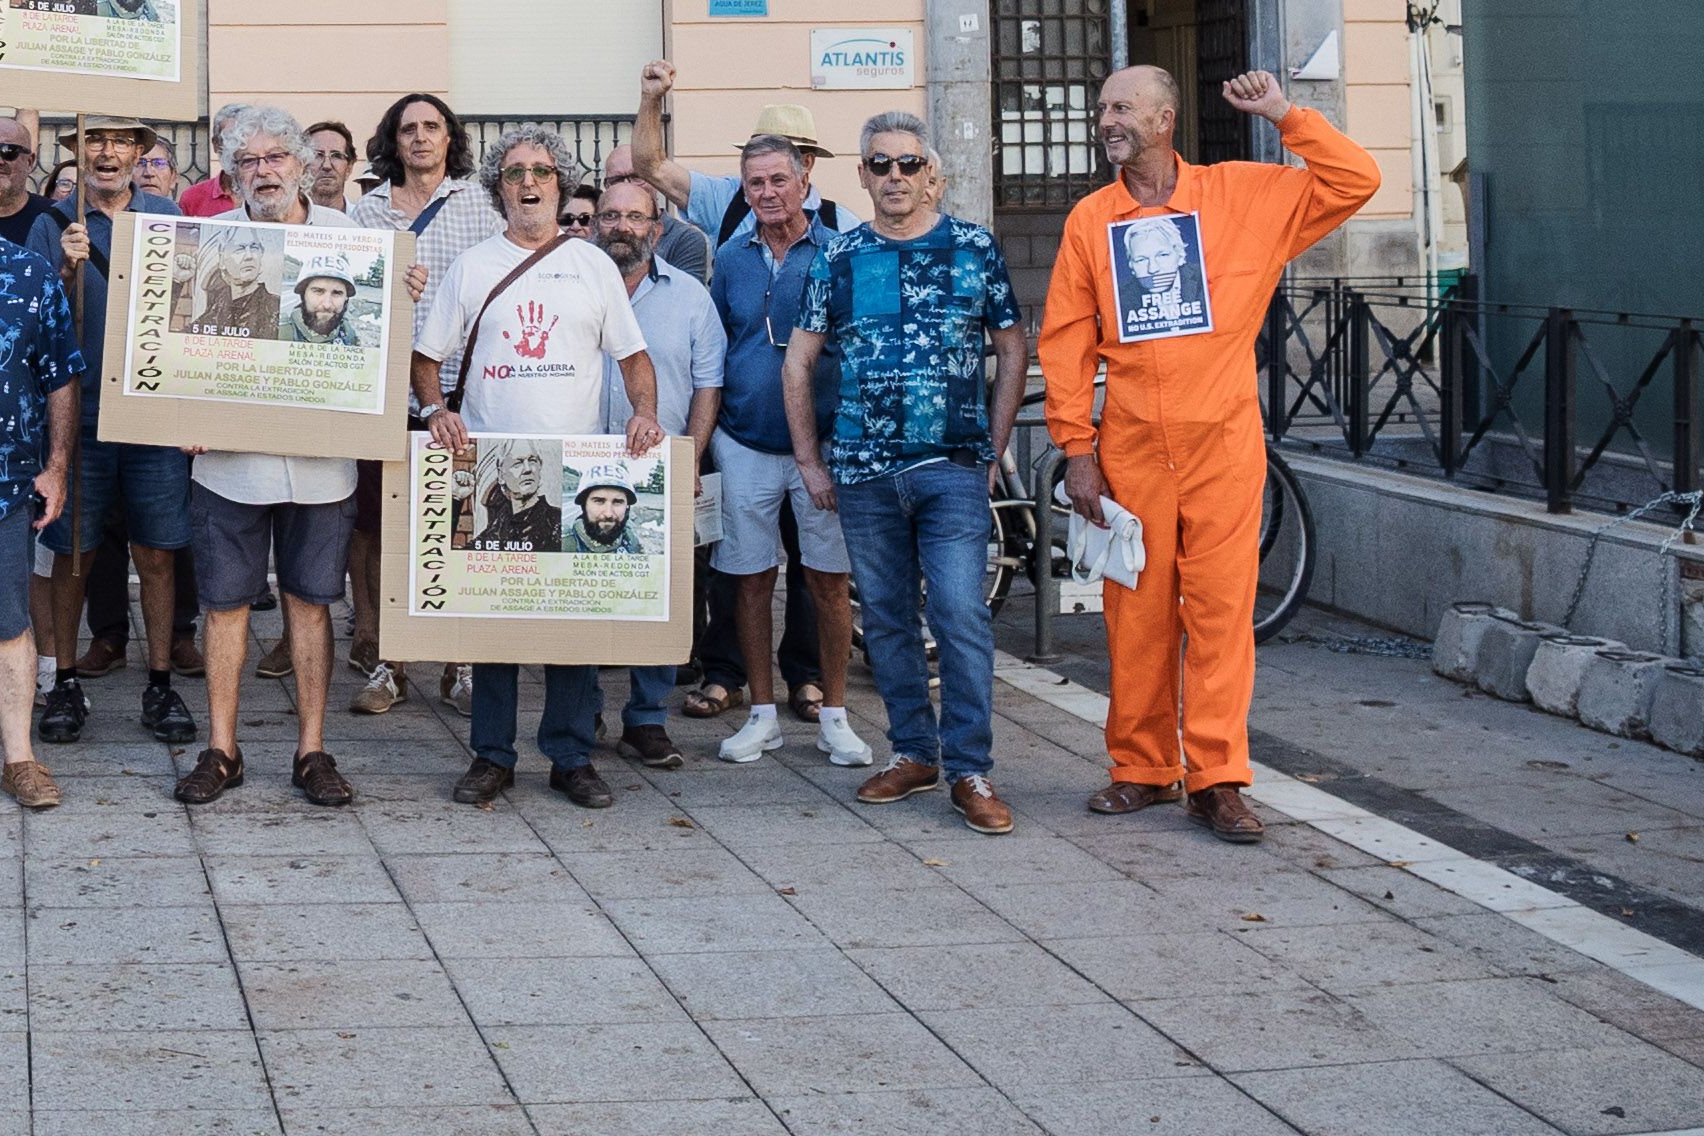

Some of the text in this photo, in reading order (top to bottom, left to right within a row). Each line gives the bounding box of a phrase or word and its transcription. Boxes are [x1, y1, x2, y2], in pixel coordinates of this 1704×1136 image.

[821, 51, 904, 66] ATLANTIS
[856, 68, 904, 79] seguros
[1141, 291, 1183, 308] FREE
[1127, 300, 1203, 324] ASSANGE
[192, 323, 250, 337] 5 DE JULIO
[183, 346, 256, 360] PLAZA ARENAL
[215, 361, 331, 377] POR LA LIBERTAD DE
[483, 364, 510, 380] NO
[536, 363, 575, 372] GUERRA
[173, 369, 372, 392] JULIAN ASSAGE Y PABLO GONZÁLEZ
[474, 540, 532, 550] 5 DE JULIO
[466, 563, 540, 574] PLAZA ARENAL
[500, 576, 615, 587] POR LA LIBERTAD DE
[458, 587, 658, 599] JULIAN ASSAGE Y PABLO GONZÁLEZ
